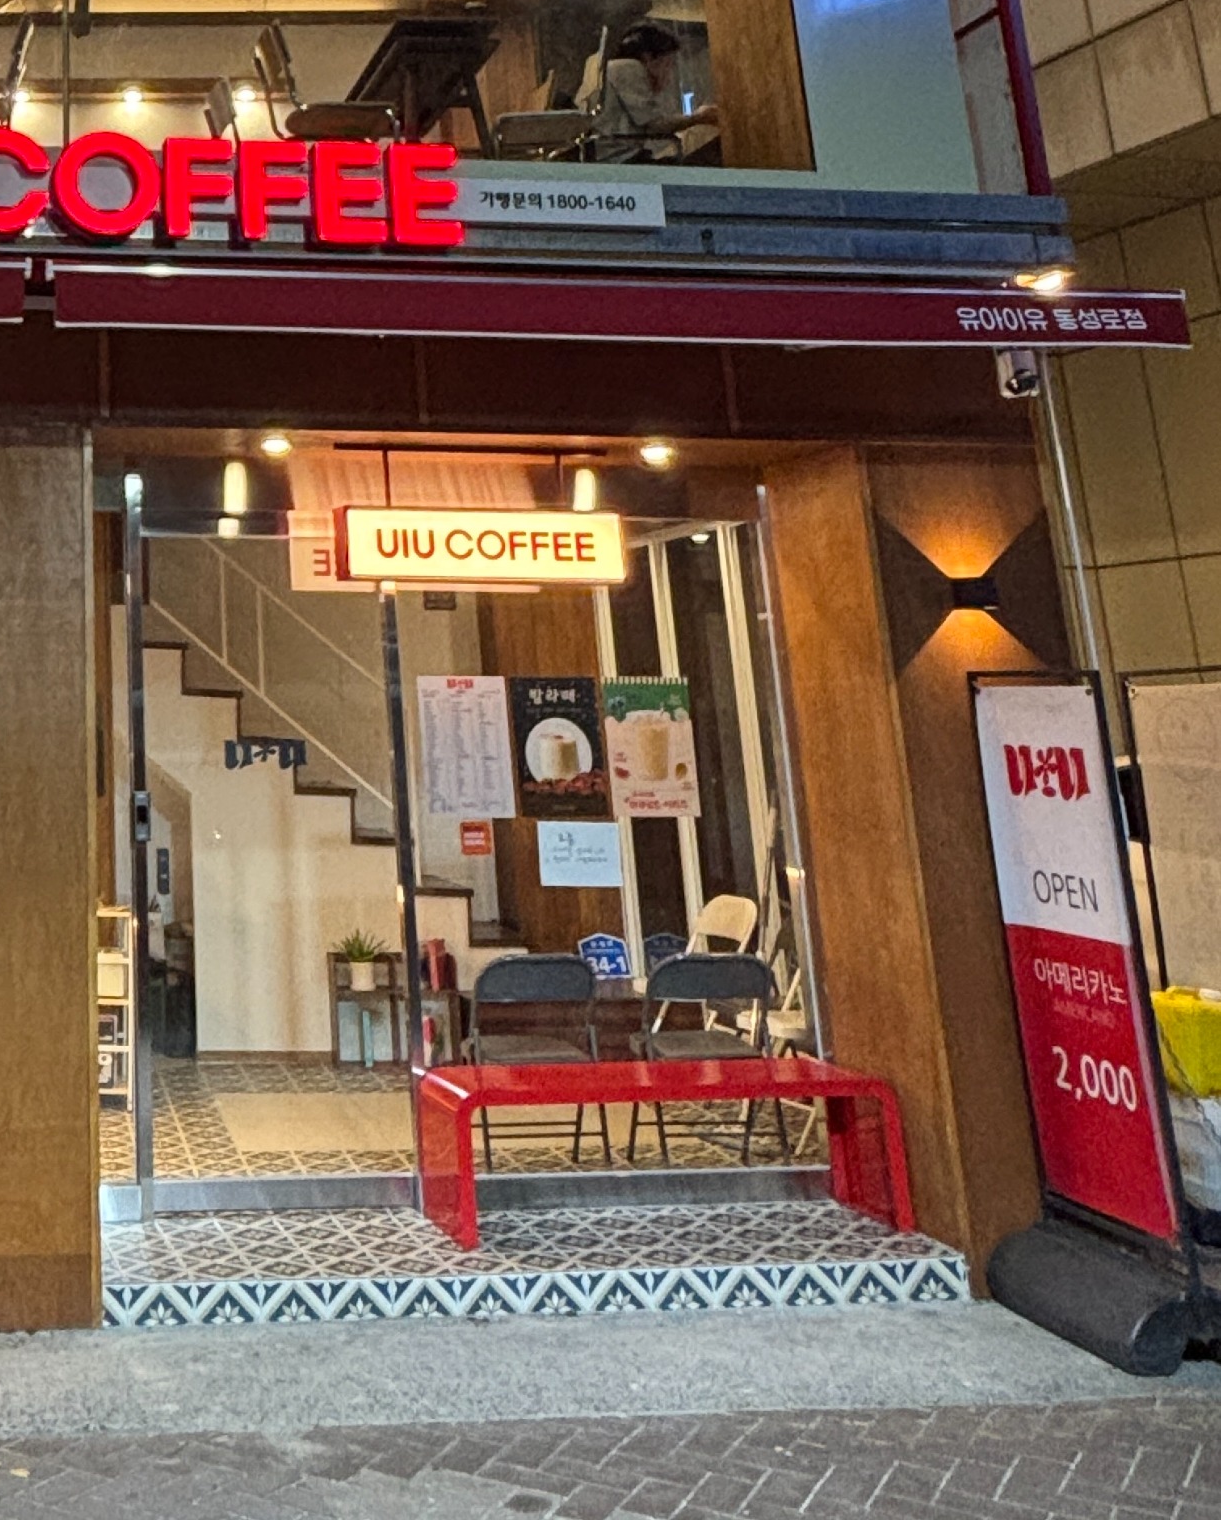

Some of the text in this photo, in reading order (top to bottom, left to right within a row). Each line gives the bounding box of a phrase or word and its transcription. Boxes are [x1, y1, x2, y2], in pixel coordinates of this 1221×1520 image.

[479, 191, 636, 211] 가맹문의 1800-1640
[956, 306, 1148, 331] 유아이유 동성로점
[376, 528, 597, 562] UIU COFFEE
[1033, 869, 1100, 913] OPEN
[1034, 957, 1128, 1006] 아메리카노
[1051, 1045, 1138, 1112] 2,000
